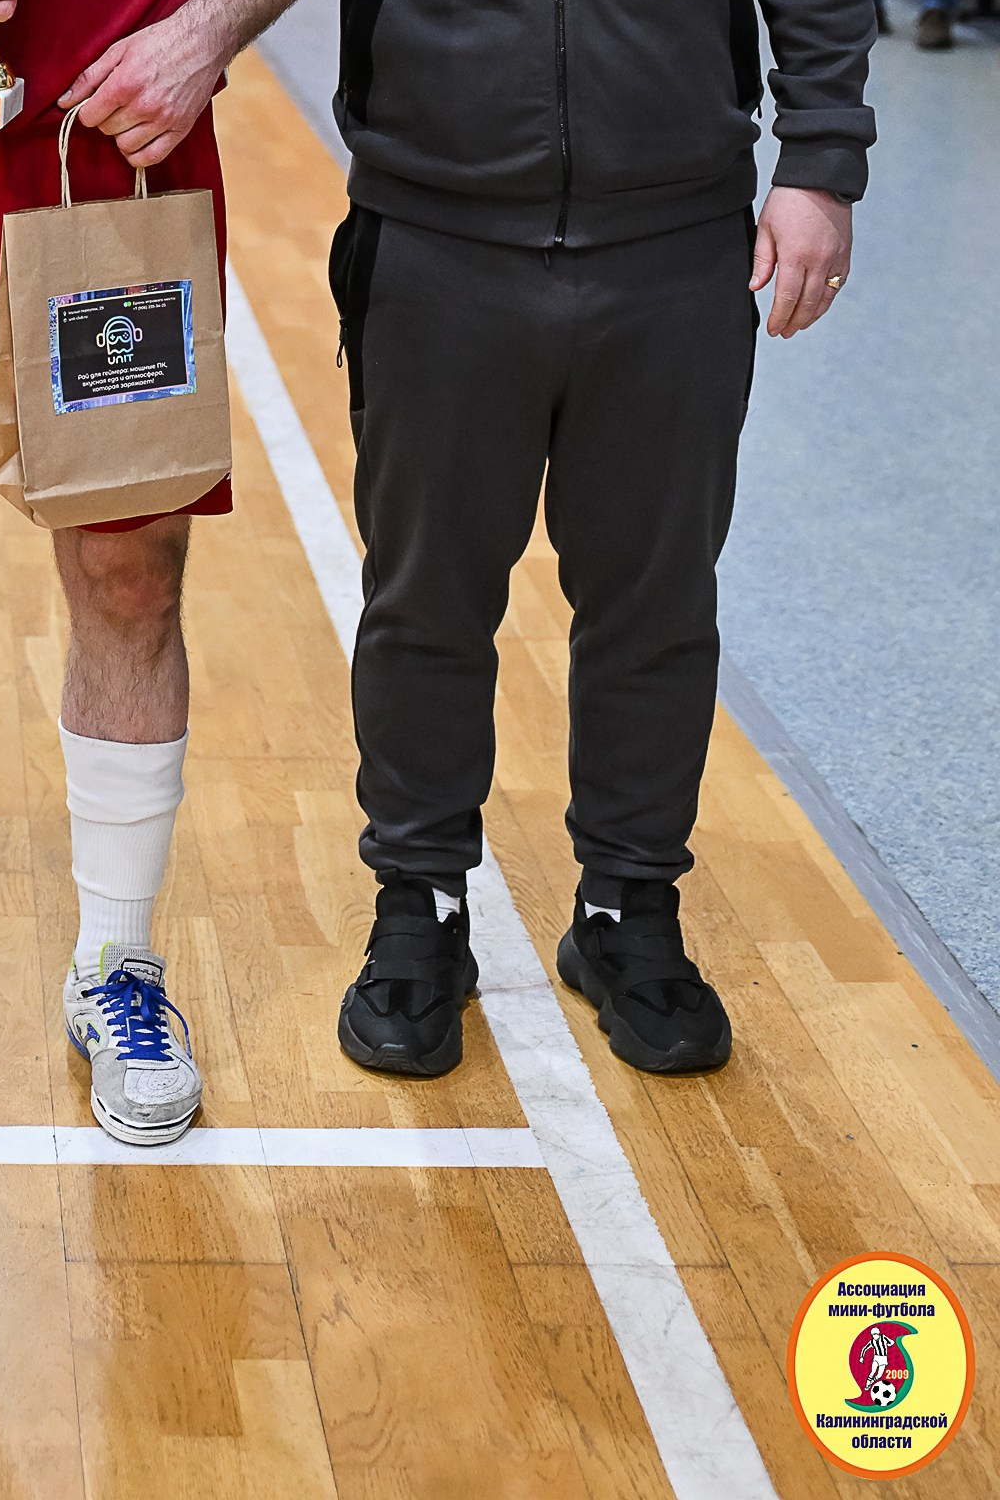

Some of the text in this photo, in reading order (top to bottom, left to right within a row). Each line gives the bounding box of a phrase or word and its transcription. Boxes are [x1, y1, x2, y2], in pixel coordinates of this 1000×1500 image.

[77, 361, 168, 381] Рай для геймера: мощные ПК,
[82, 379, 107, 388] вкусная
[107, 376, 119, 384] еда
[124, 370, 165, 380] атмосфера,
[92, 378, 155, 393] которая заряжает!
